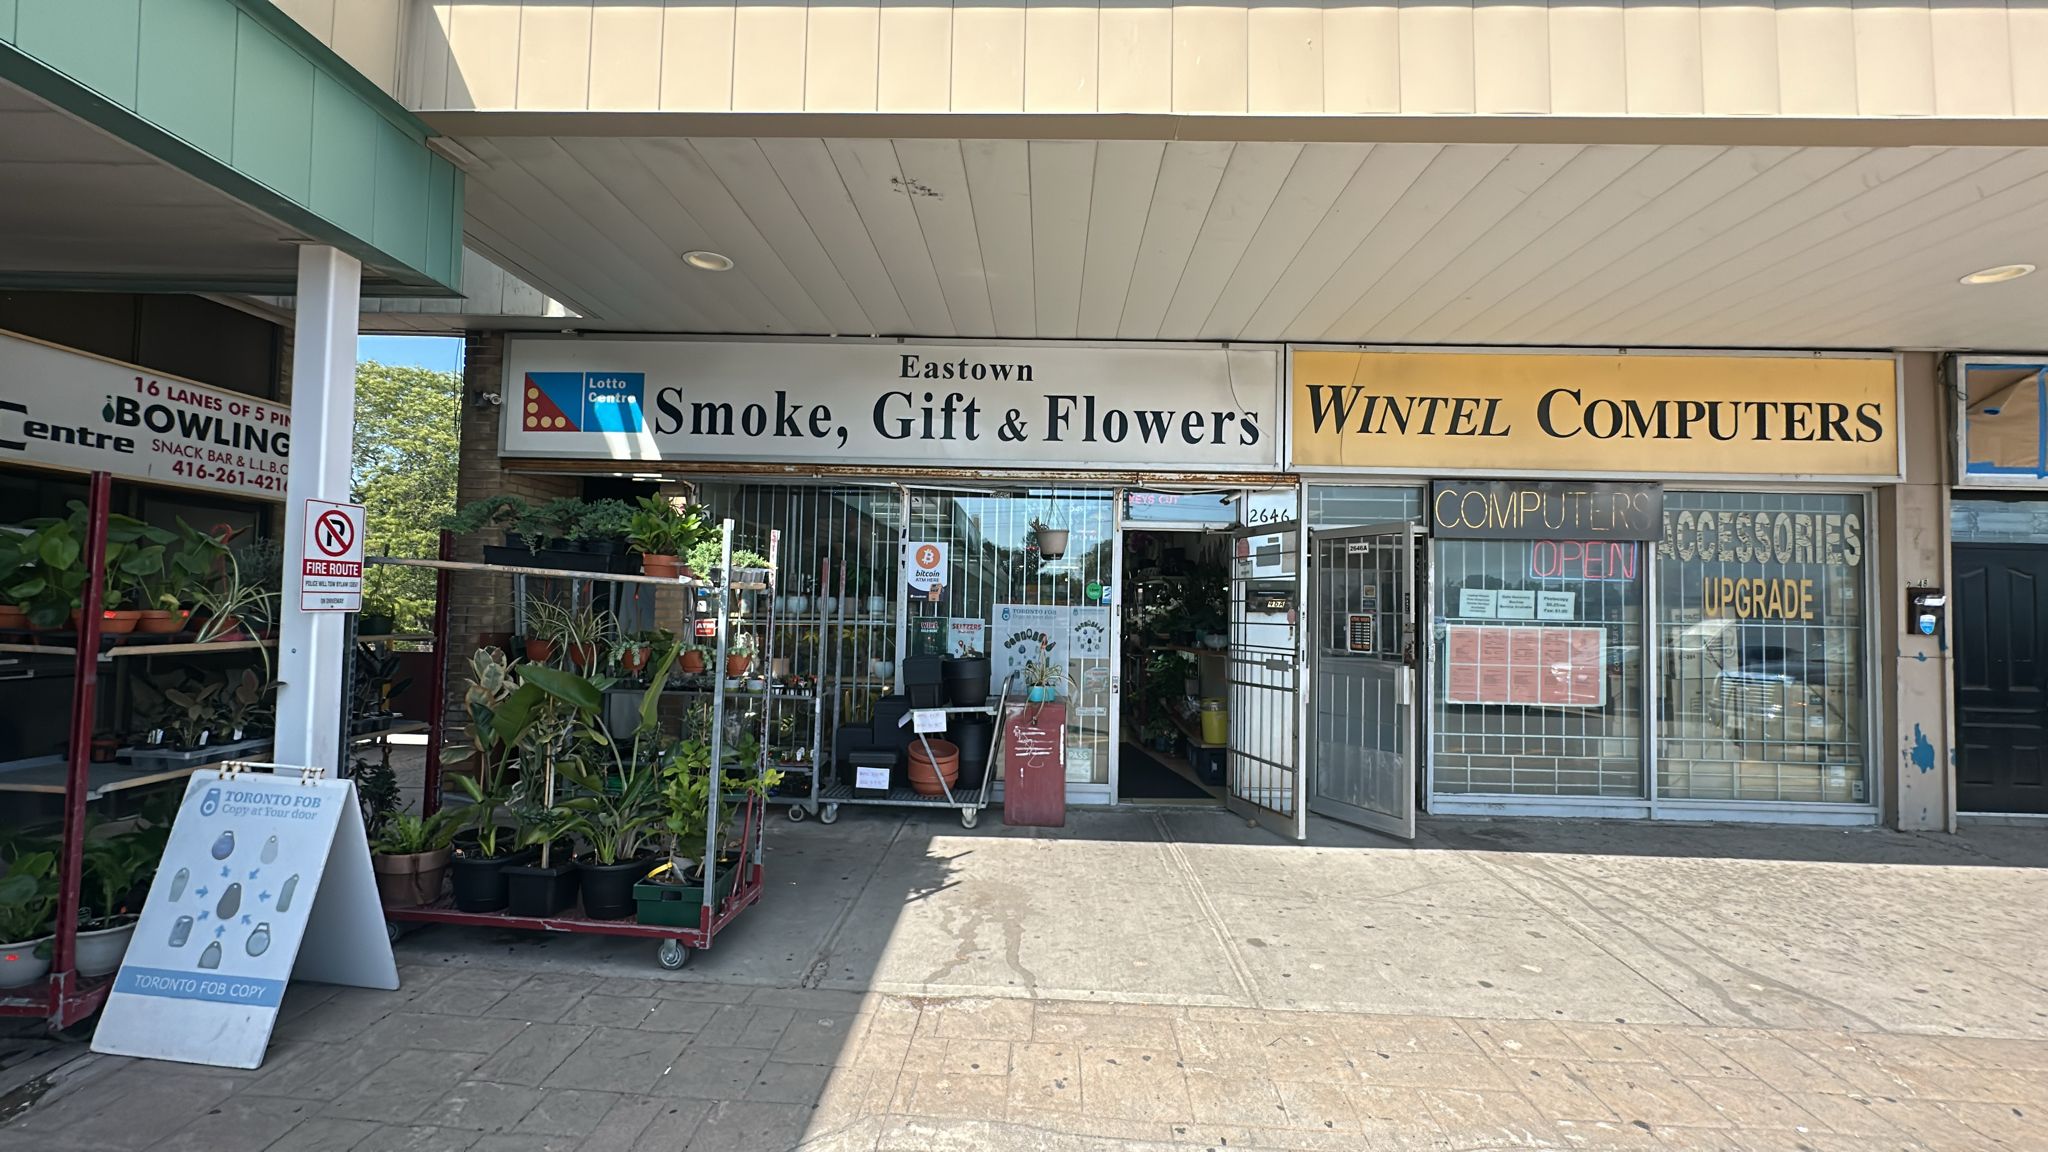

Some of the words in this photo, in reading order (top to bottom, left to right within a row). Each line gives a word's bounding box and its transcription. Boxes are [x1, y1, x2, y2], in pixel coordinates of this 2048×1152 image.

[898, 354, 1034, 382] Eastown
[589, 378, 627, 389] Lotto
[135, 377, 160, 397] 16
[167, 386, 223, 412] LANES
[229, 402, 250, 417] OF
[255, 407, 265, 421] 5
[588, 392, 637, 404] Centre
[115, 395, 290, 457] BOWLING
[655, 387, 848, 449] Smoke,
[872, 390, 981, 441] Gift
[997, 408, 1029, 442] &
[1042, 394, 1260, 446] Flowers
[1305, 384, 1511, 437] WINTEL
[1536, 388, 1883, 443] COMPUTERS
[152, 439, 203, 460] SNACK
[207, 450, 233, 466] BAR
[236, 455, 245, 467] &
[172, 460, 288, 492] 416-261-421
[1129, 493, 1155, 505] KEYS
[1158, 495, 1179, 505] CUT
[1435, 489, 1651, 531] COMPUTERS
[1249, 508, 1290, 523] 2646
[1657, 510, 1861, 566] ACCESSORIES
[306, 561, 328, 575] FIRE
[329, 562, 359, 576] ROUTE
[1532, 541, 1634, 578] OPEN
[915, 569, 940, 577] bitcoin
[1704, 576, 1813, 620] UPGRADE
[1013, 608, 1043, 616] TORONTO
[1068, 752, 1089, 760] PASS
[222, 803, 250, 817] Copy
[250, 807, 262, 816] at
[263, 806, 290, 818] Your
[291, 808, 318, 820] door
[224, 790, 292, 806] TORONTO
[293, 795, 322, 809] FOB
[135, 974, 197, 993] TORONTO
[199, 981, 226, 995] FOB
[230, 984, 267, 998] COPY
